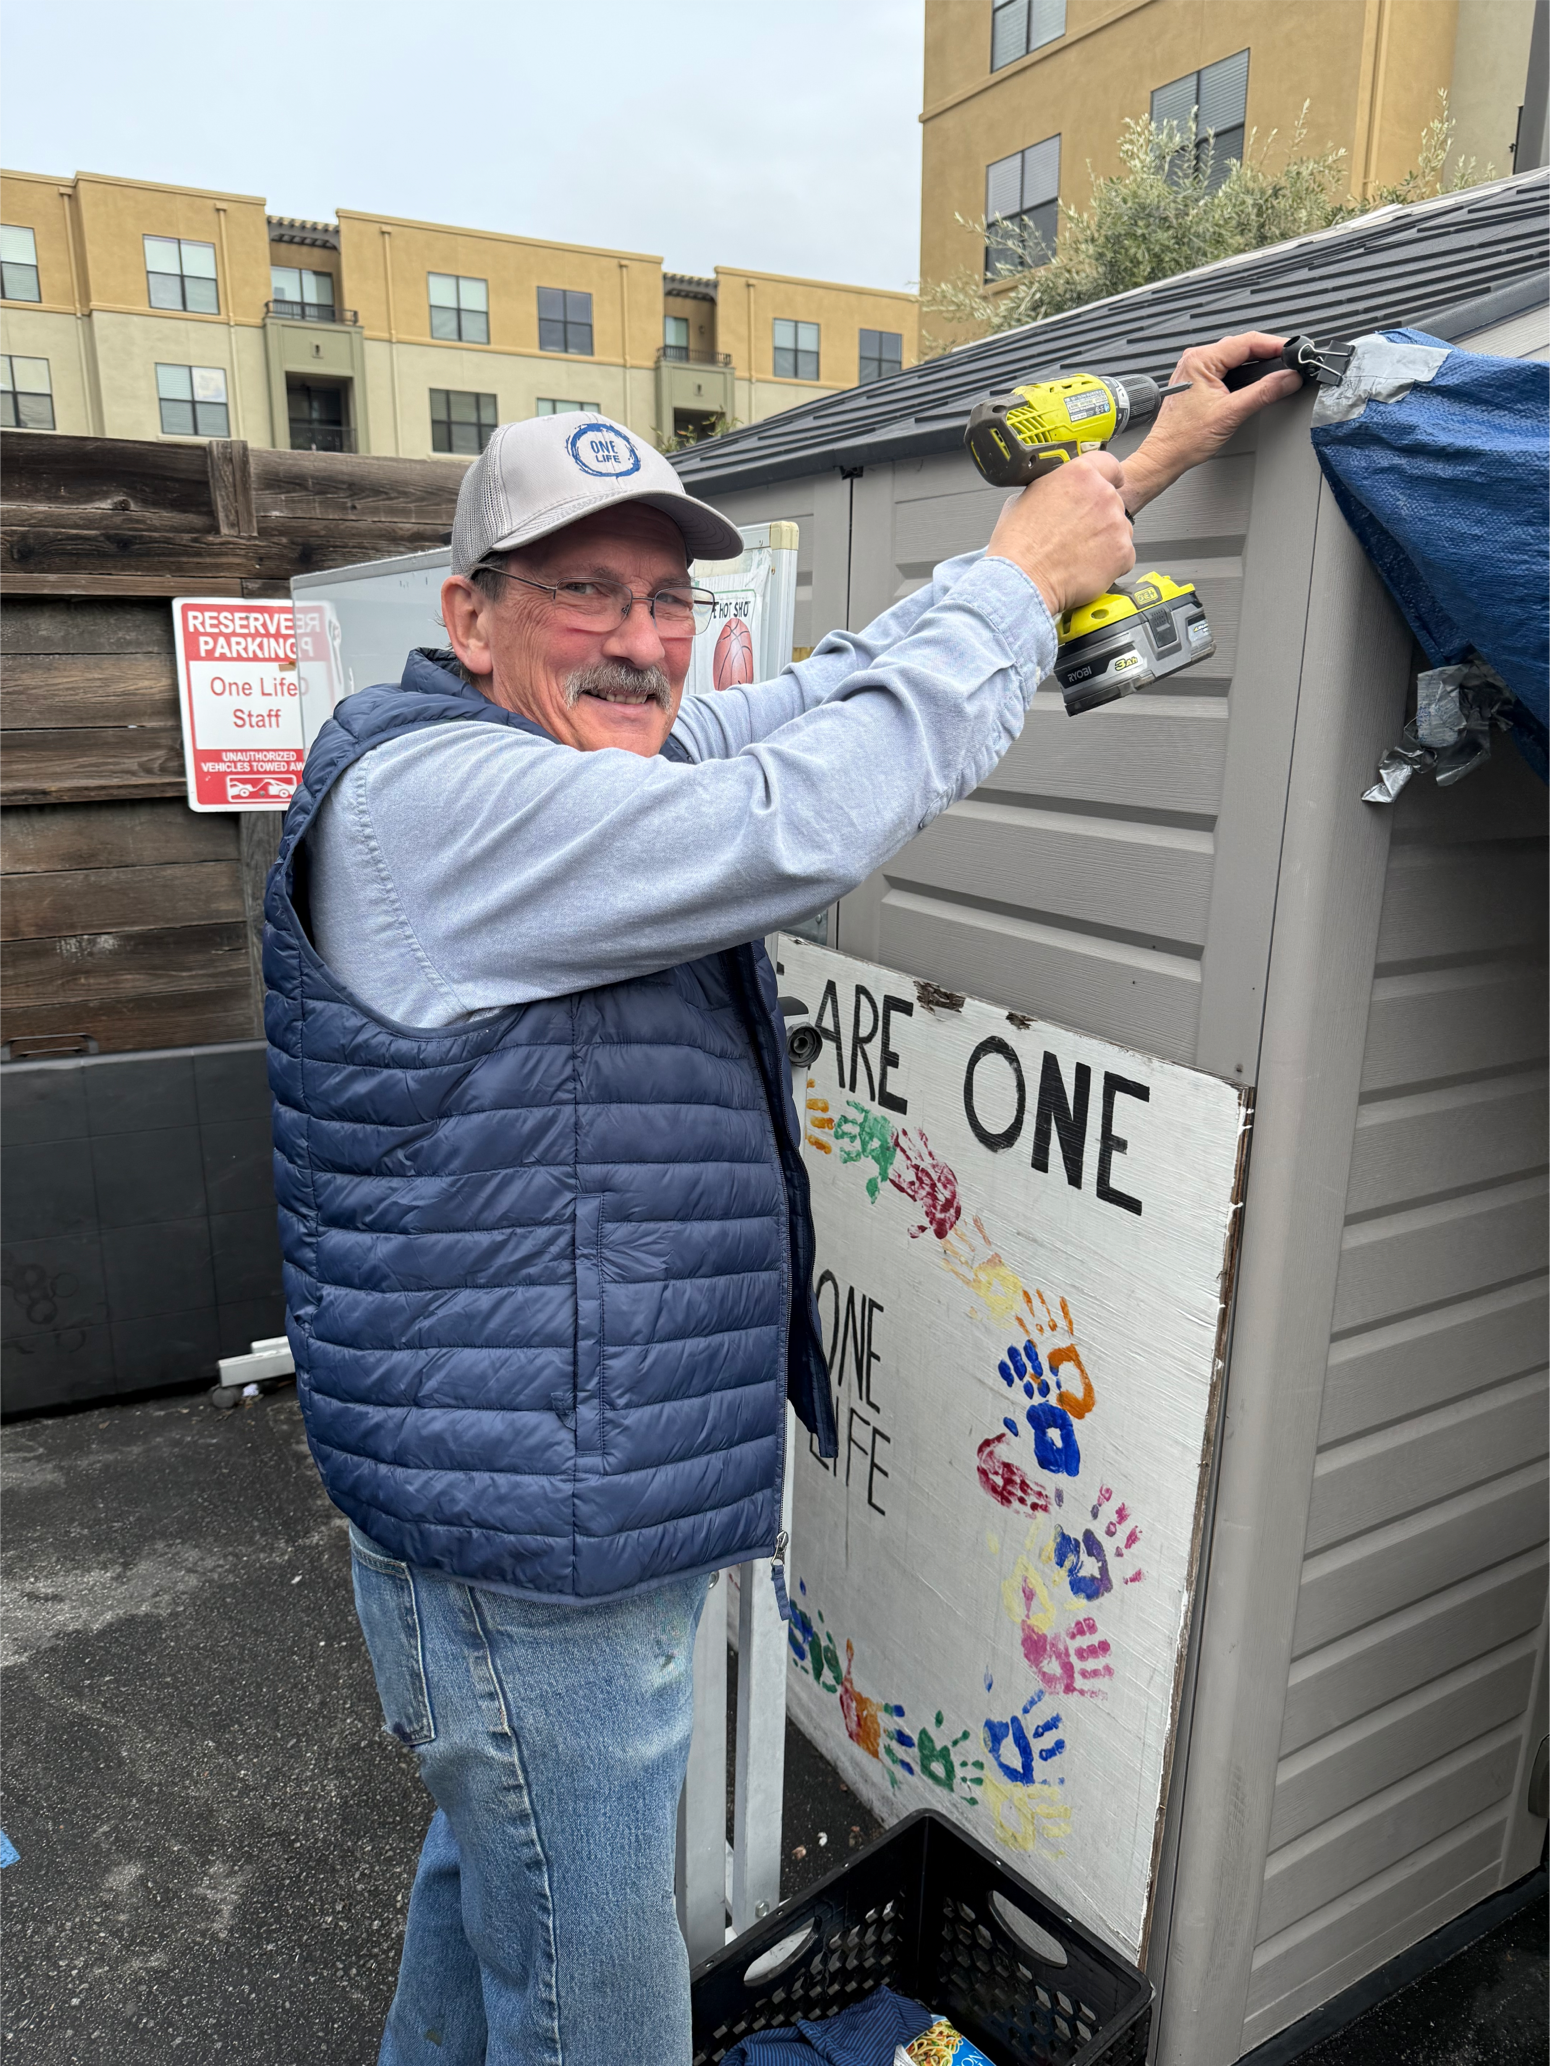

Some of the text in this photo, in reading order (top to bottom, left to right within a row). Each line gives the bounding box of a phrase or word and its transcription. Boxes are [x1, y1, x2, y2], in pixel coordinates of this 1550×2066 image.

[590, 440, 618, 454] ONE
[595, 454, 621, 463] LIFE
[187, 611, 295, 634] RESERVE
[199, 636, 297, 659] PARKING
[1067, 666, 1092, 682] RYOBI
[210, 676, 298, 697] One Life
[233, 708, 281, 728] Staff
[201, 761, 304, 772] VEHICLES TOWED AW
[222, 751, 296, 762] UNAUTHORIZED
[808, 979, 1150, 1216] ARE ONE
[816, 1269, 884, 1414] ONE
